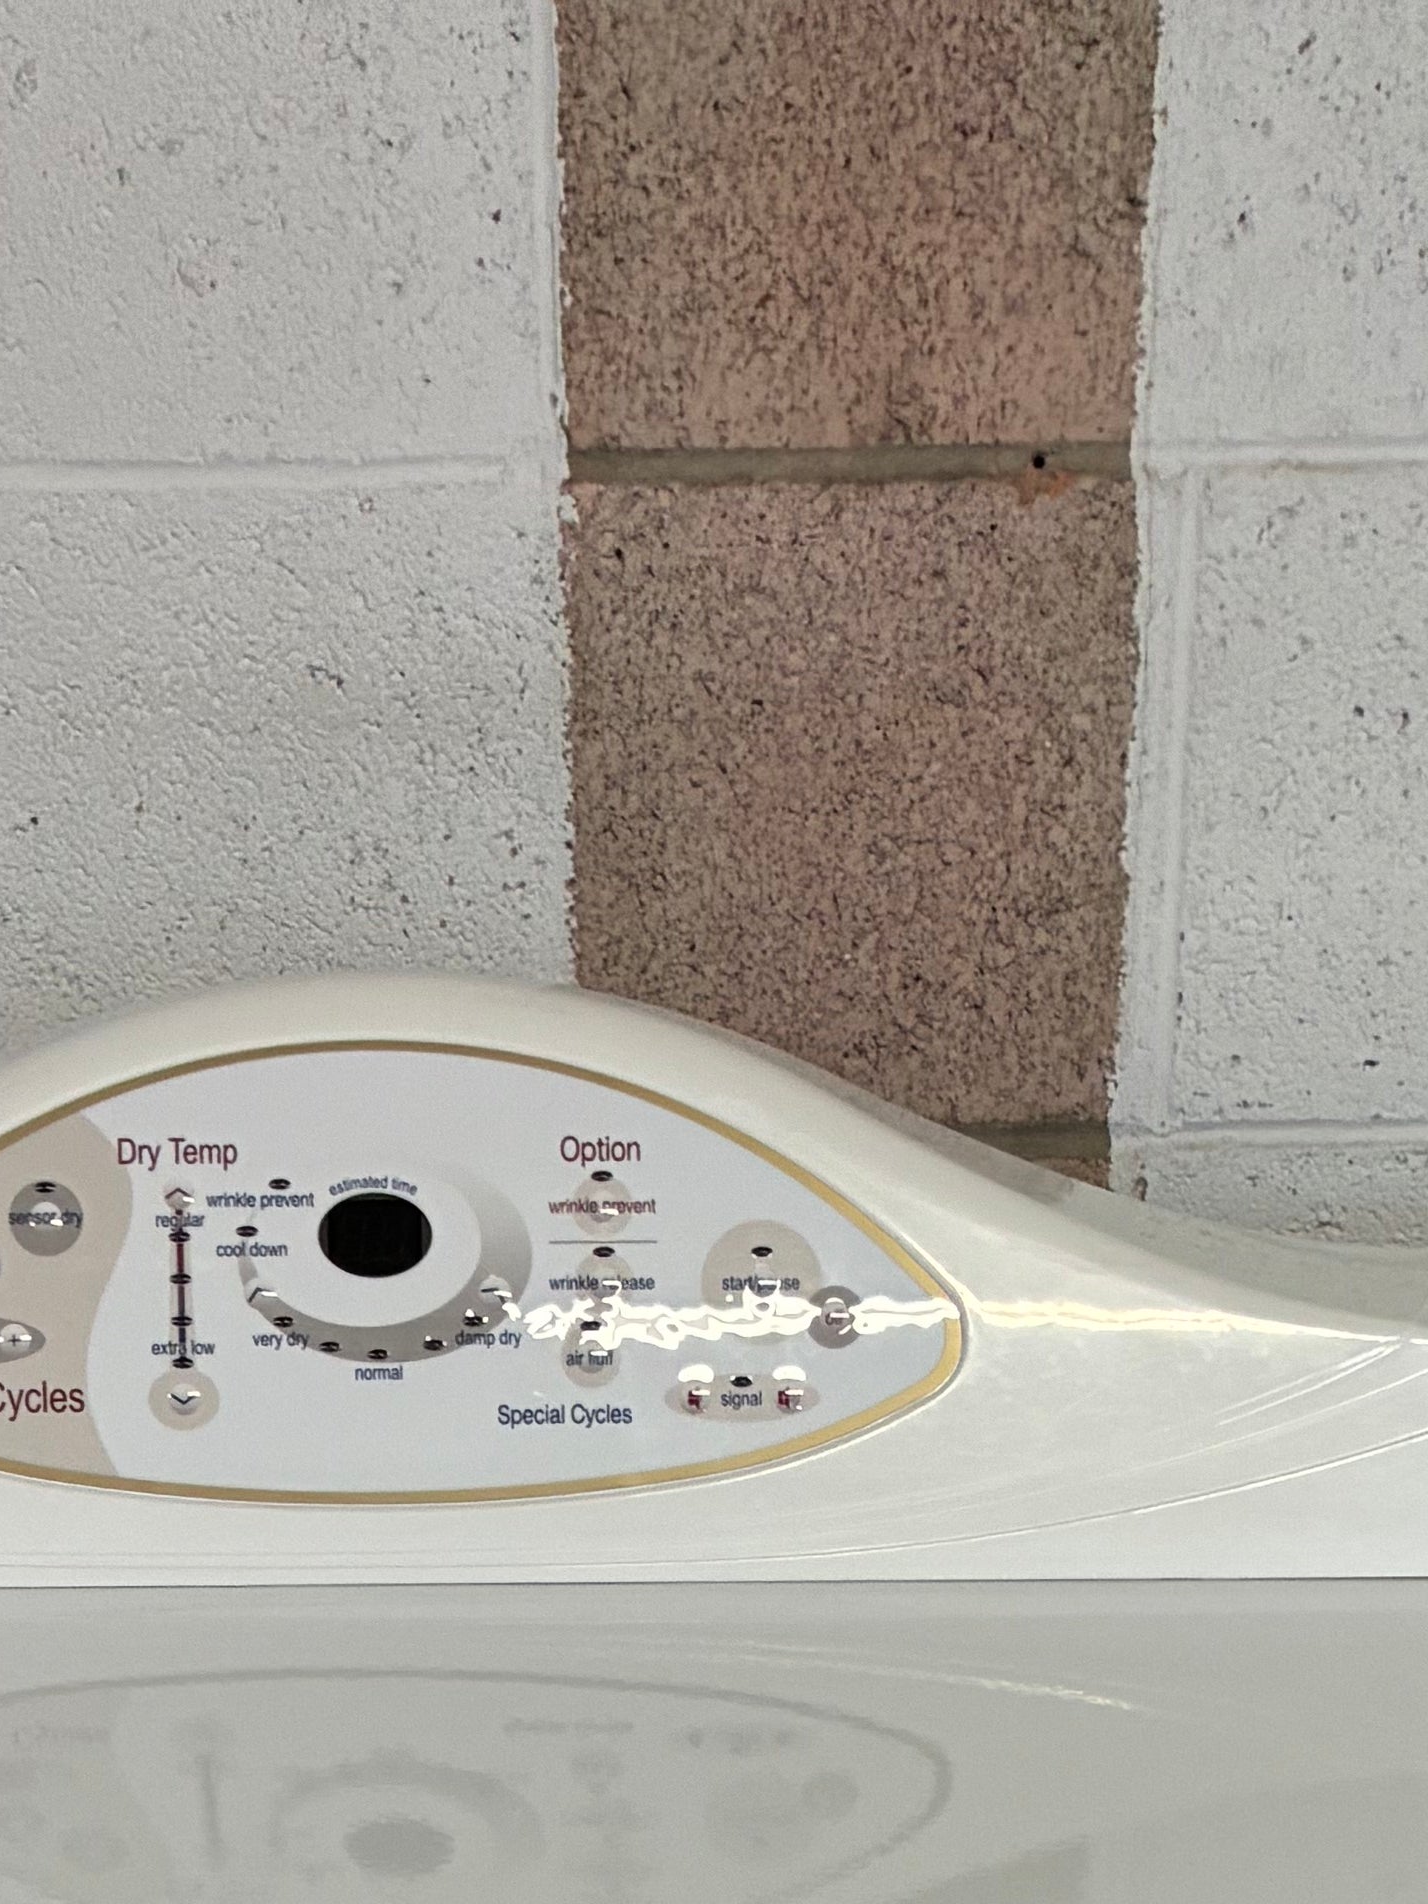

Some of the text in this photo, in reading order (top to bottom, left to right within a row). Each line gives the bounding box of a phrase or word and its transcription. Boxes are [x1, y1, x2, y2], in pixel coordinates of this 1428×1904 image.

[117, 1137, 238, 1171] Dry Temp
[560, 1136, 641, 1167] Option
[328, 1176, 418, 1197] estimated time
[205, 1193, 315, 1210] wrinkle prevent
[548, 1199, 598, 1214] wrinkle
[8, 1208, 83, 1229] sensor dry
[216, 1242, 288, 1257] cool down
[548, 1274, 656, 1291] wrinkle ease
[721, 1274, 801, 1294] start/pse
[151, 1339, 216, 1356] extra low
[252, 1331, 310, 1350] very dry
[454, 1330, 522, 1348] damp dry
[565, 1350, 584, 1366] air
[354, 1365, 404, 1381] normal
[720, 1390, 763, 1411] signal
[497, 1403, 633, 1429] Special Cycles
